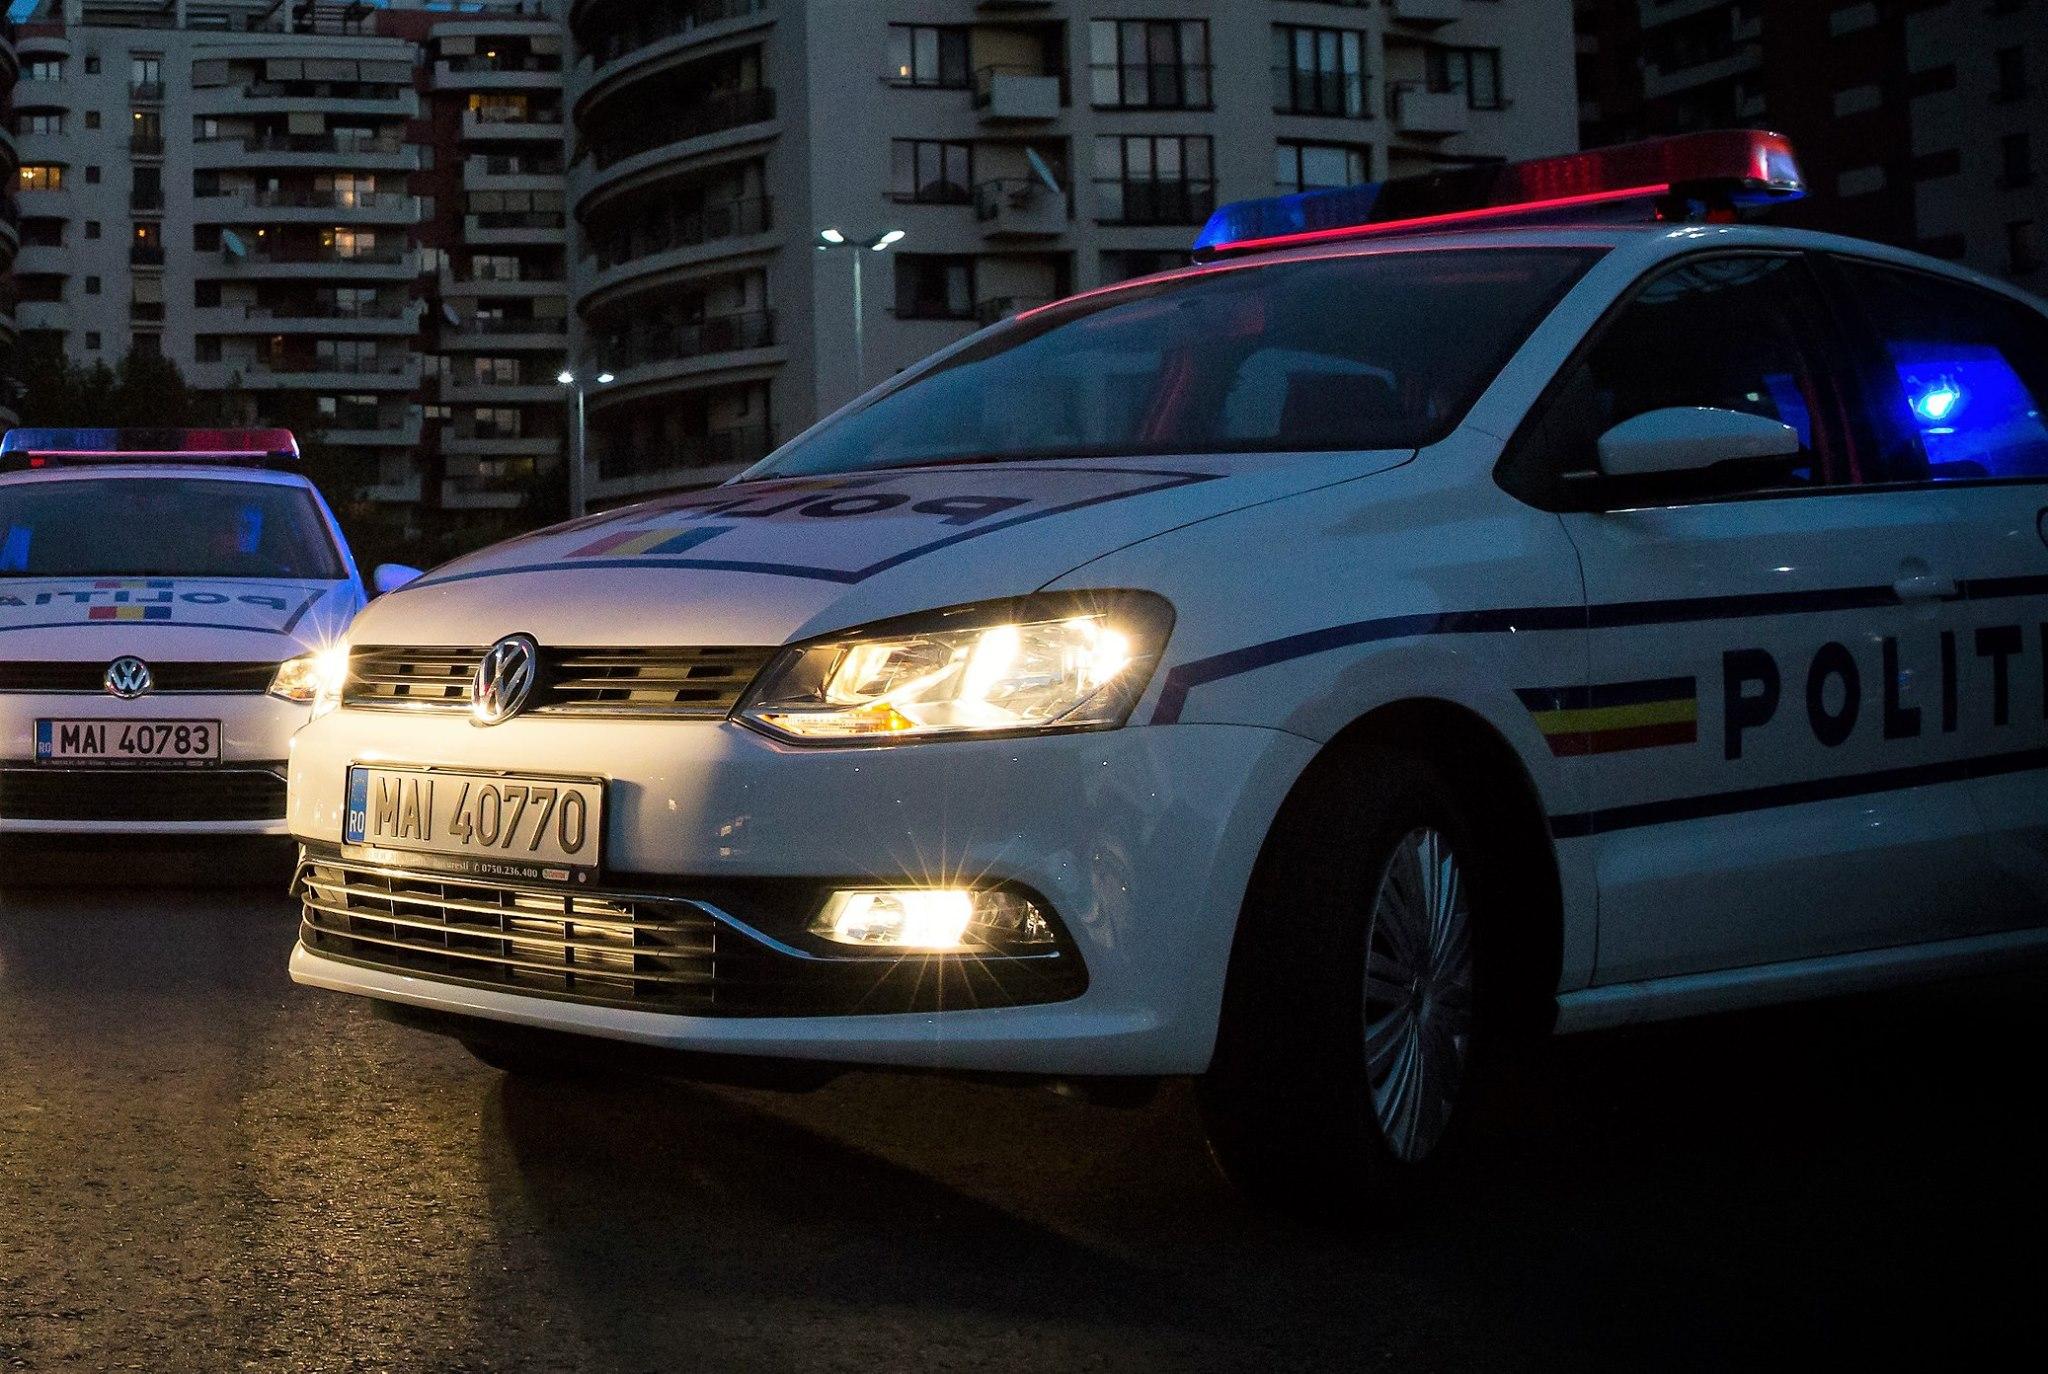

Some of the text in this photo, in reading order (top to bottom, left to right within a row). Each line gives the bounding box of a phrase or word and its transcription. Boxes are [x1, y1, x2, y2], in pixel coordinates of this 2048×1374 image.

[61, 724, 210, 755] MAI 40783
[348, 810, 365, 834] RO
[374, 776, 587, 855] MAI 40770
